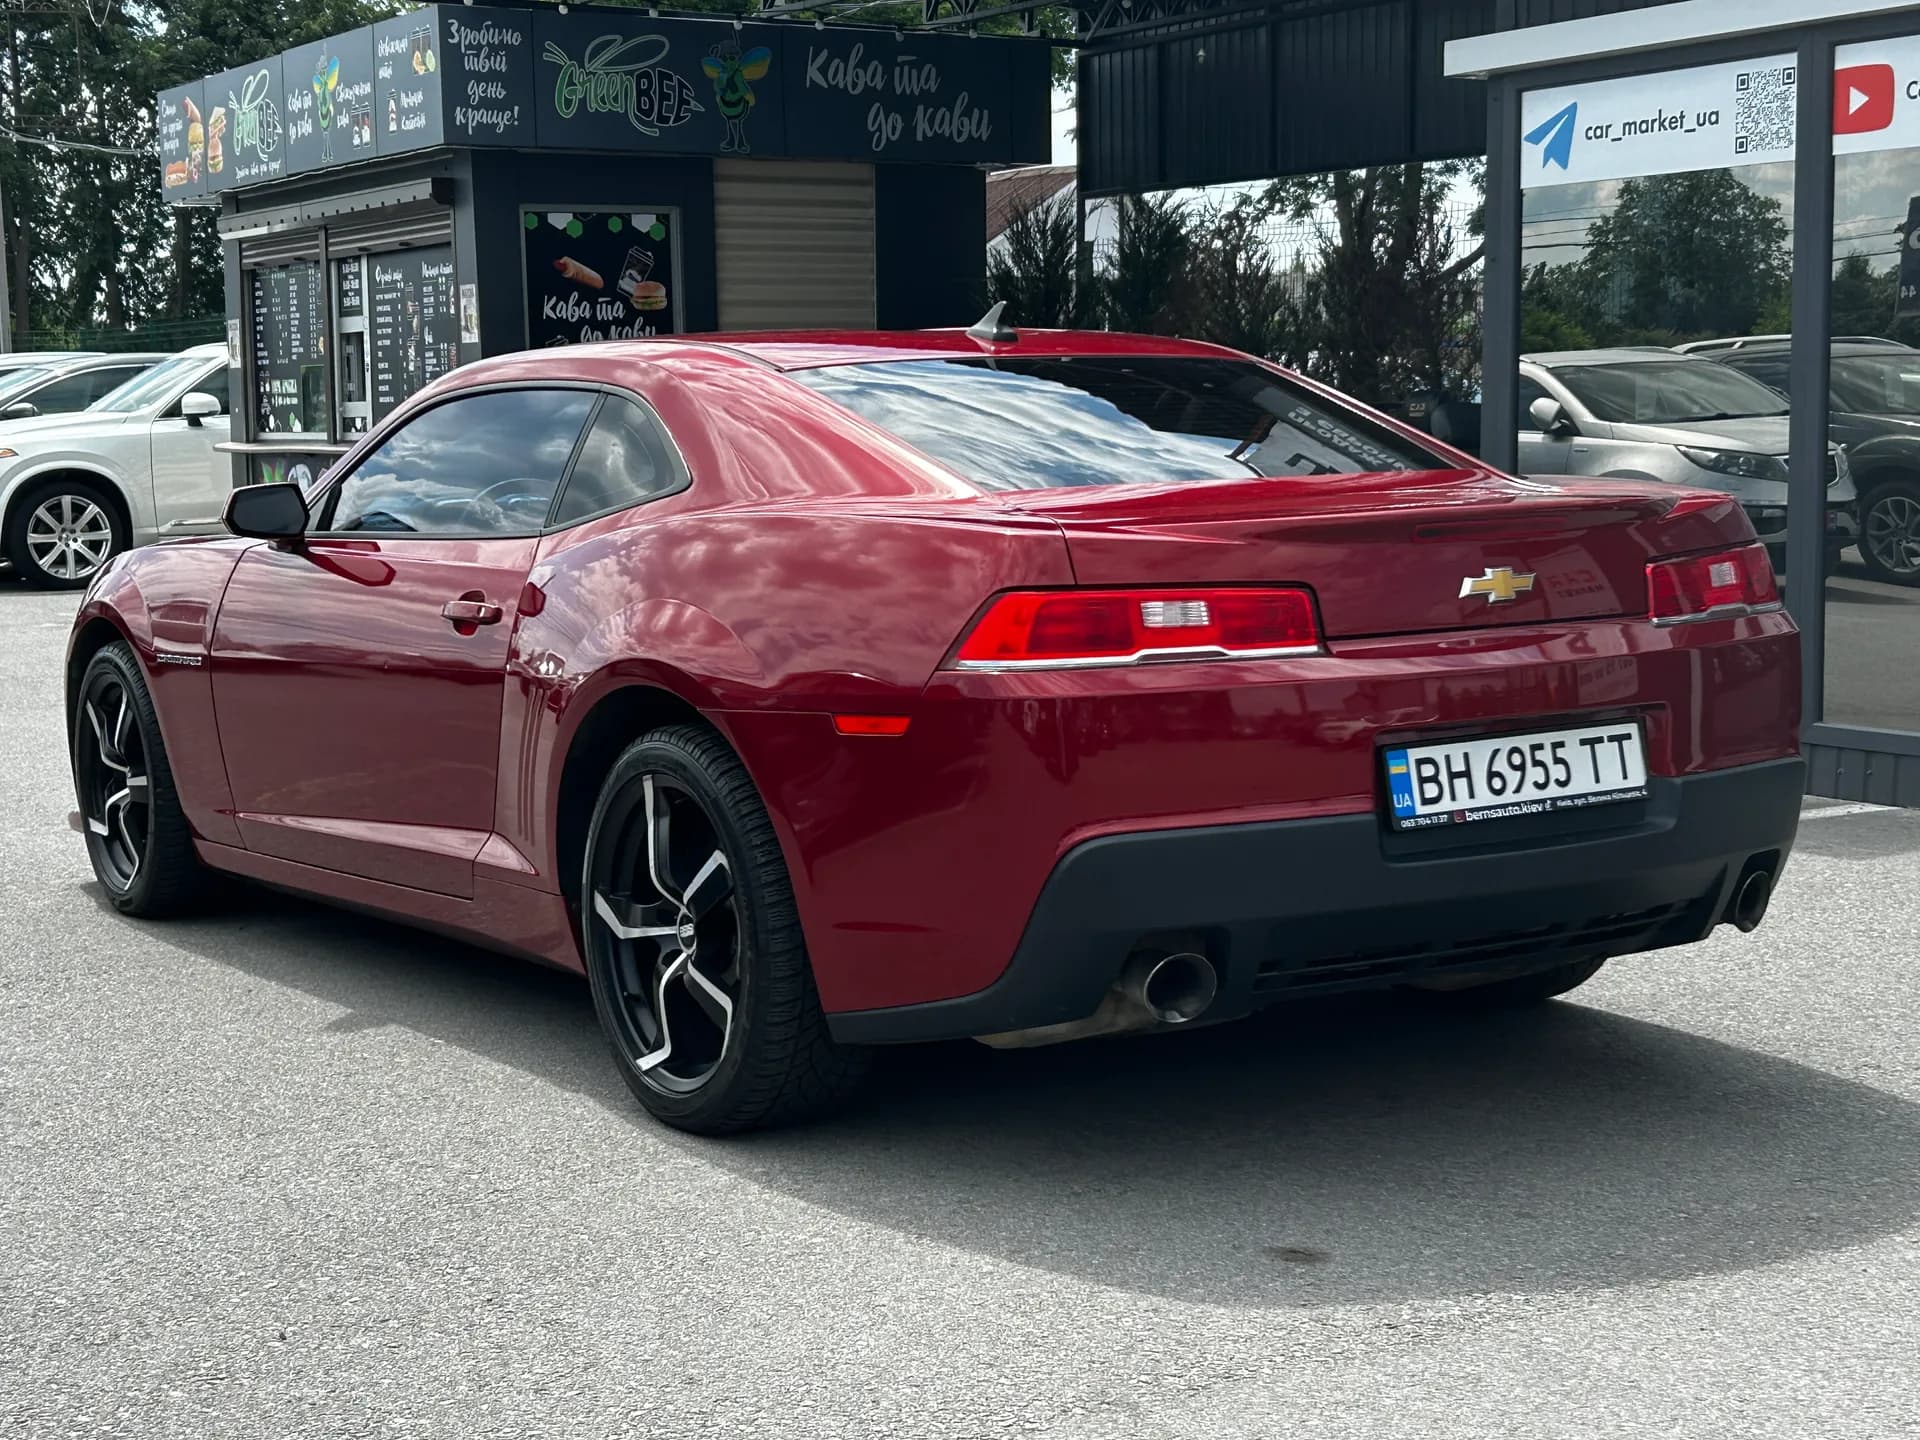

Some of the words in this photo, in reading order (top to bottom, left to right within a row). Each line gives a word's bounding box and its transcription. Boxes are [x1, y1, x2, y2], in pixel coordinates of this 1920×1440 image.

[448, 19, 522, 53] Зробимо
[464, 46, 508, 72] твій
[806, 43, 887, 95] Кава
[894, 55, 941, 96] та
[467, 80, 506, 105] день
[455, 106, 520, 135] краще!
[867, 102, 904, 151] до
[913, 91, 992, 143] кави
[1585, 109, 1720, 142] car_market_ua
[543, 291, 592, 322] Кава
[596, 297, 626, 321] та
[1414, 751, 1476, 806] BH
[1485, 740, 1572, 797] 6955
[1579, 733, 1633, 785] TT
[1393, 793, 1413, 808] UA
